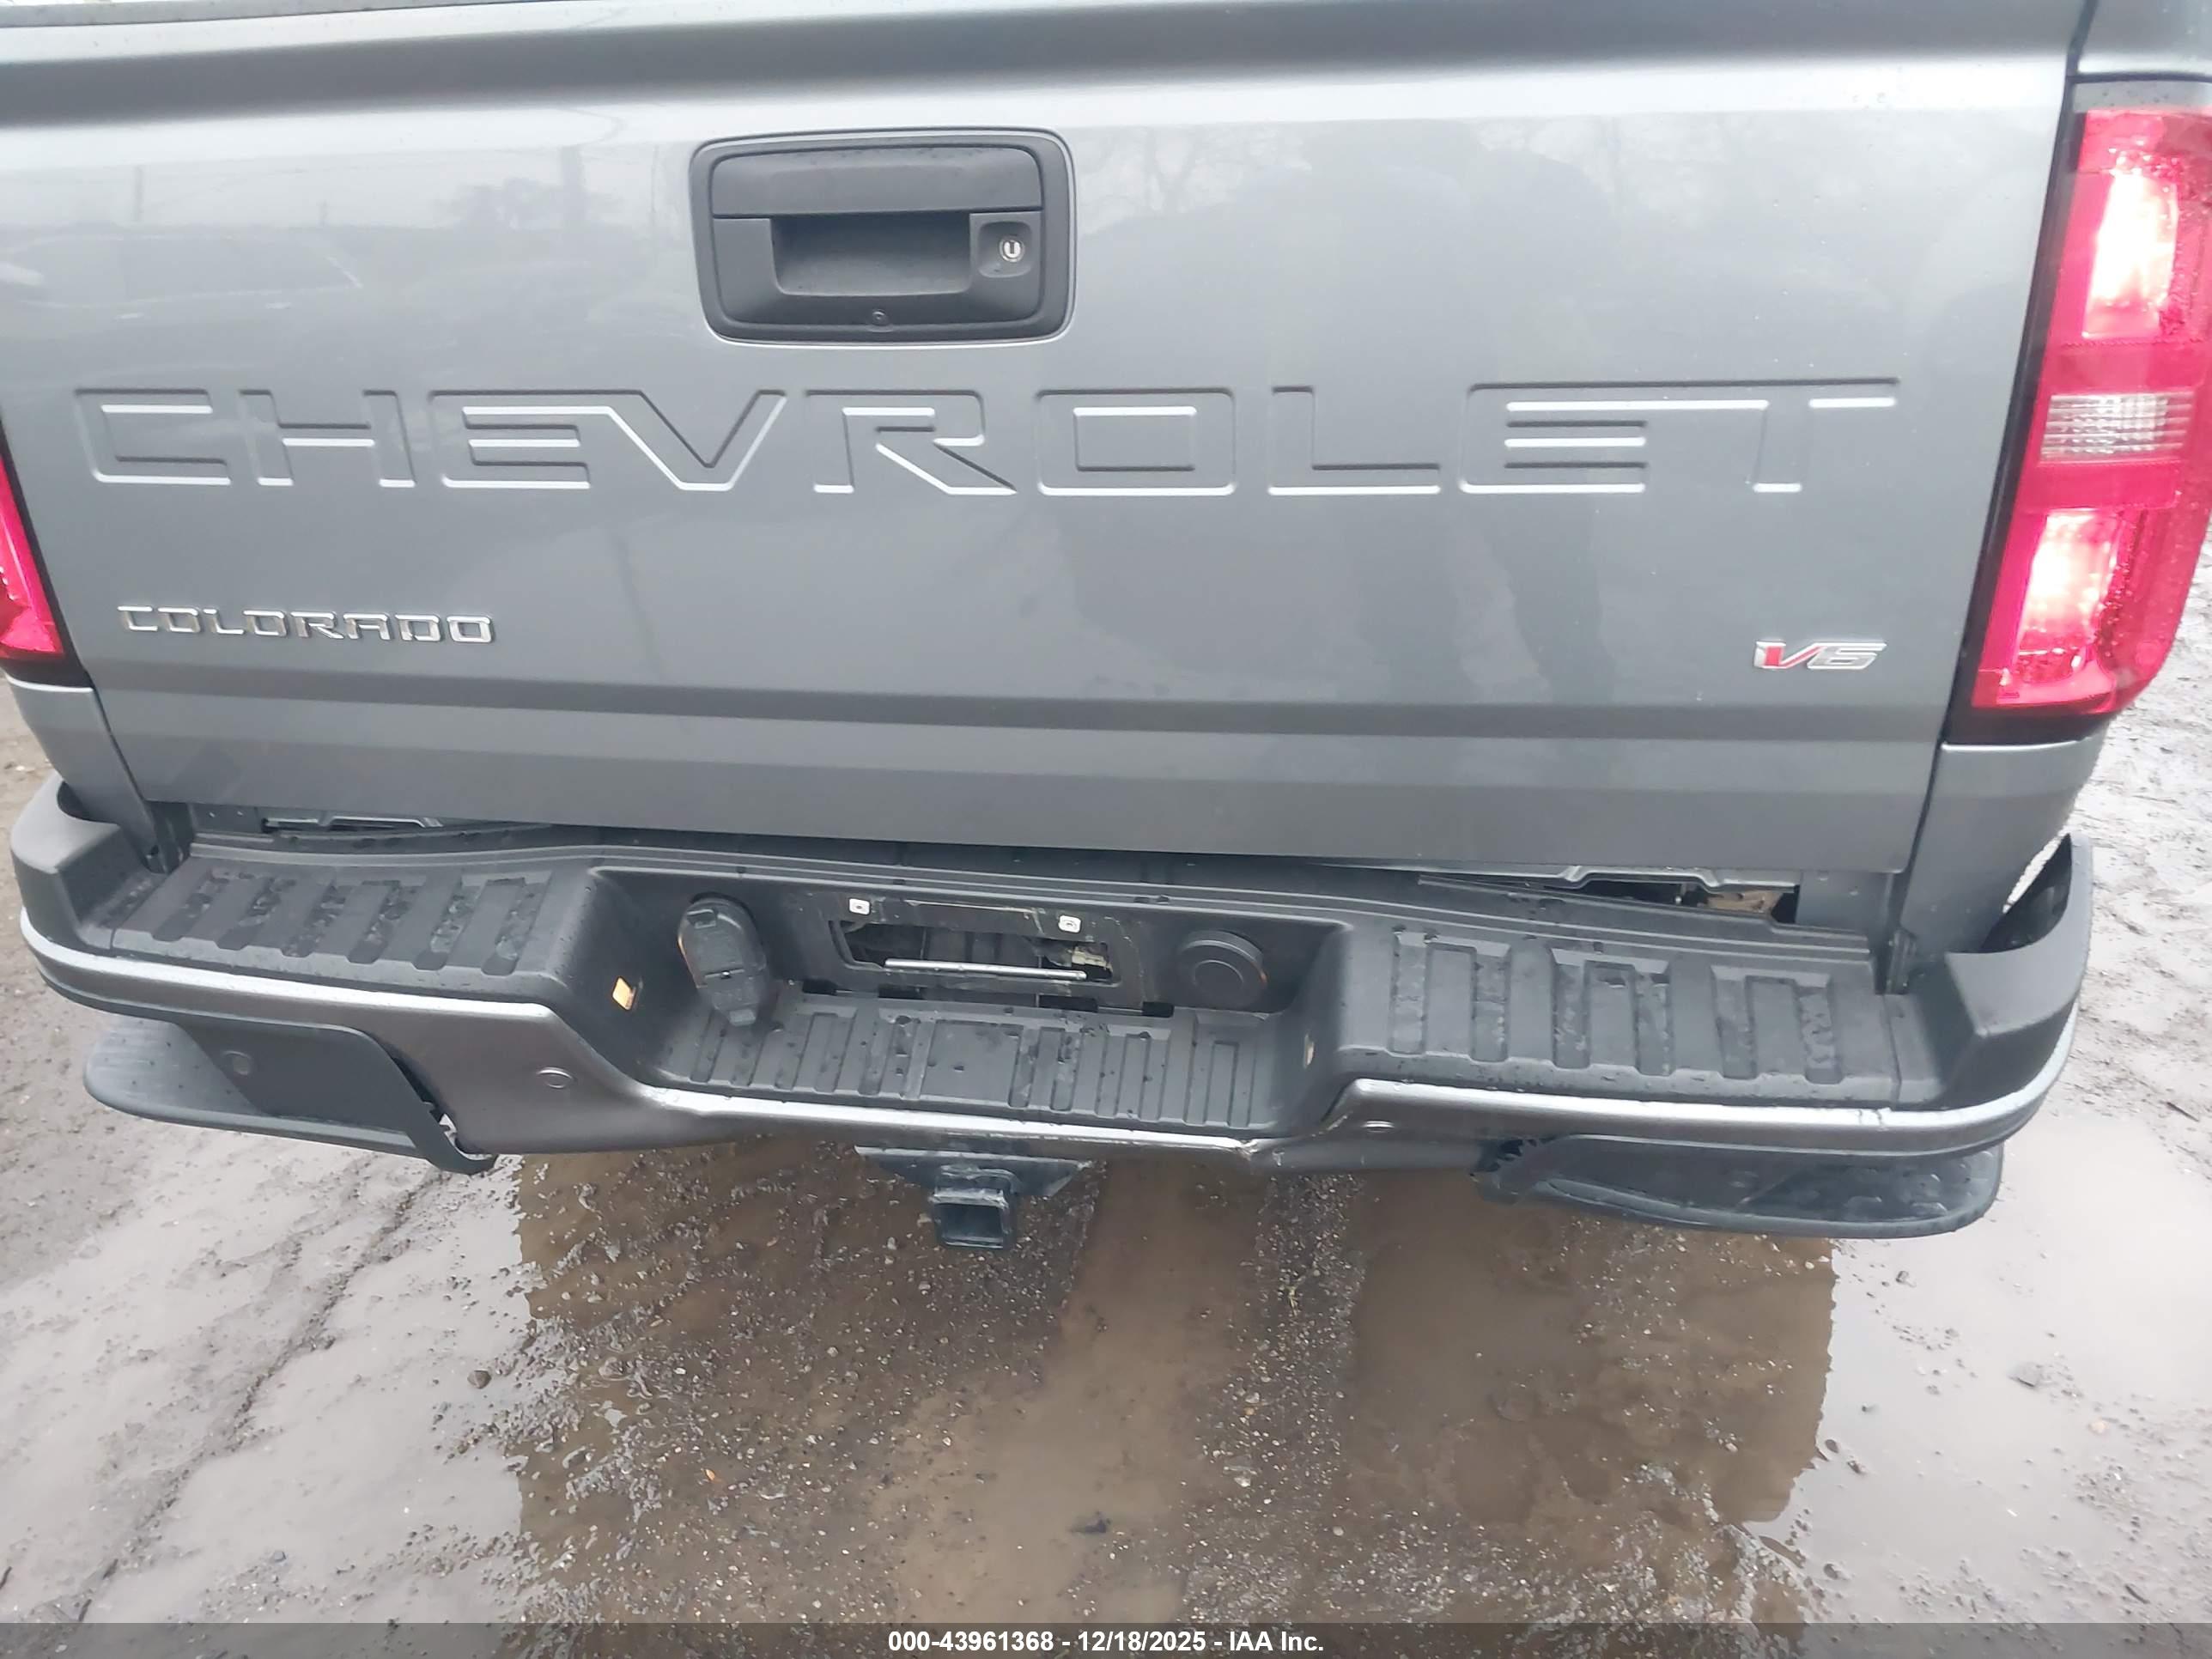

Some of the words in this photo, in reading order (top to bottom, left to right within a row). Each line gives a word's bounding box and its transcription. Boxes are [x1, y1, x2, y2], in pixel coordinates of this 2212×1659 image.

[75, 379, 1900, 496] CHEVROLET
[118, 605, 495, 644] COLORADO
[1754, 640, 1887, 671] V6
